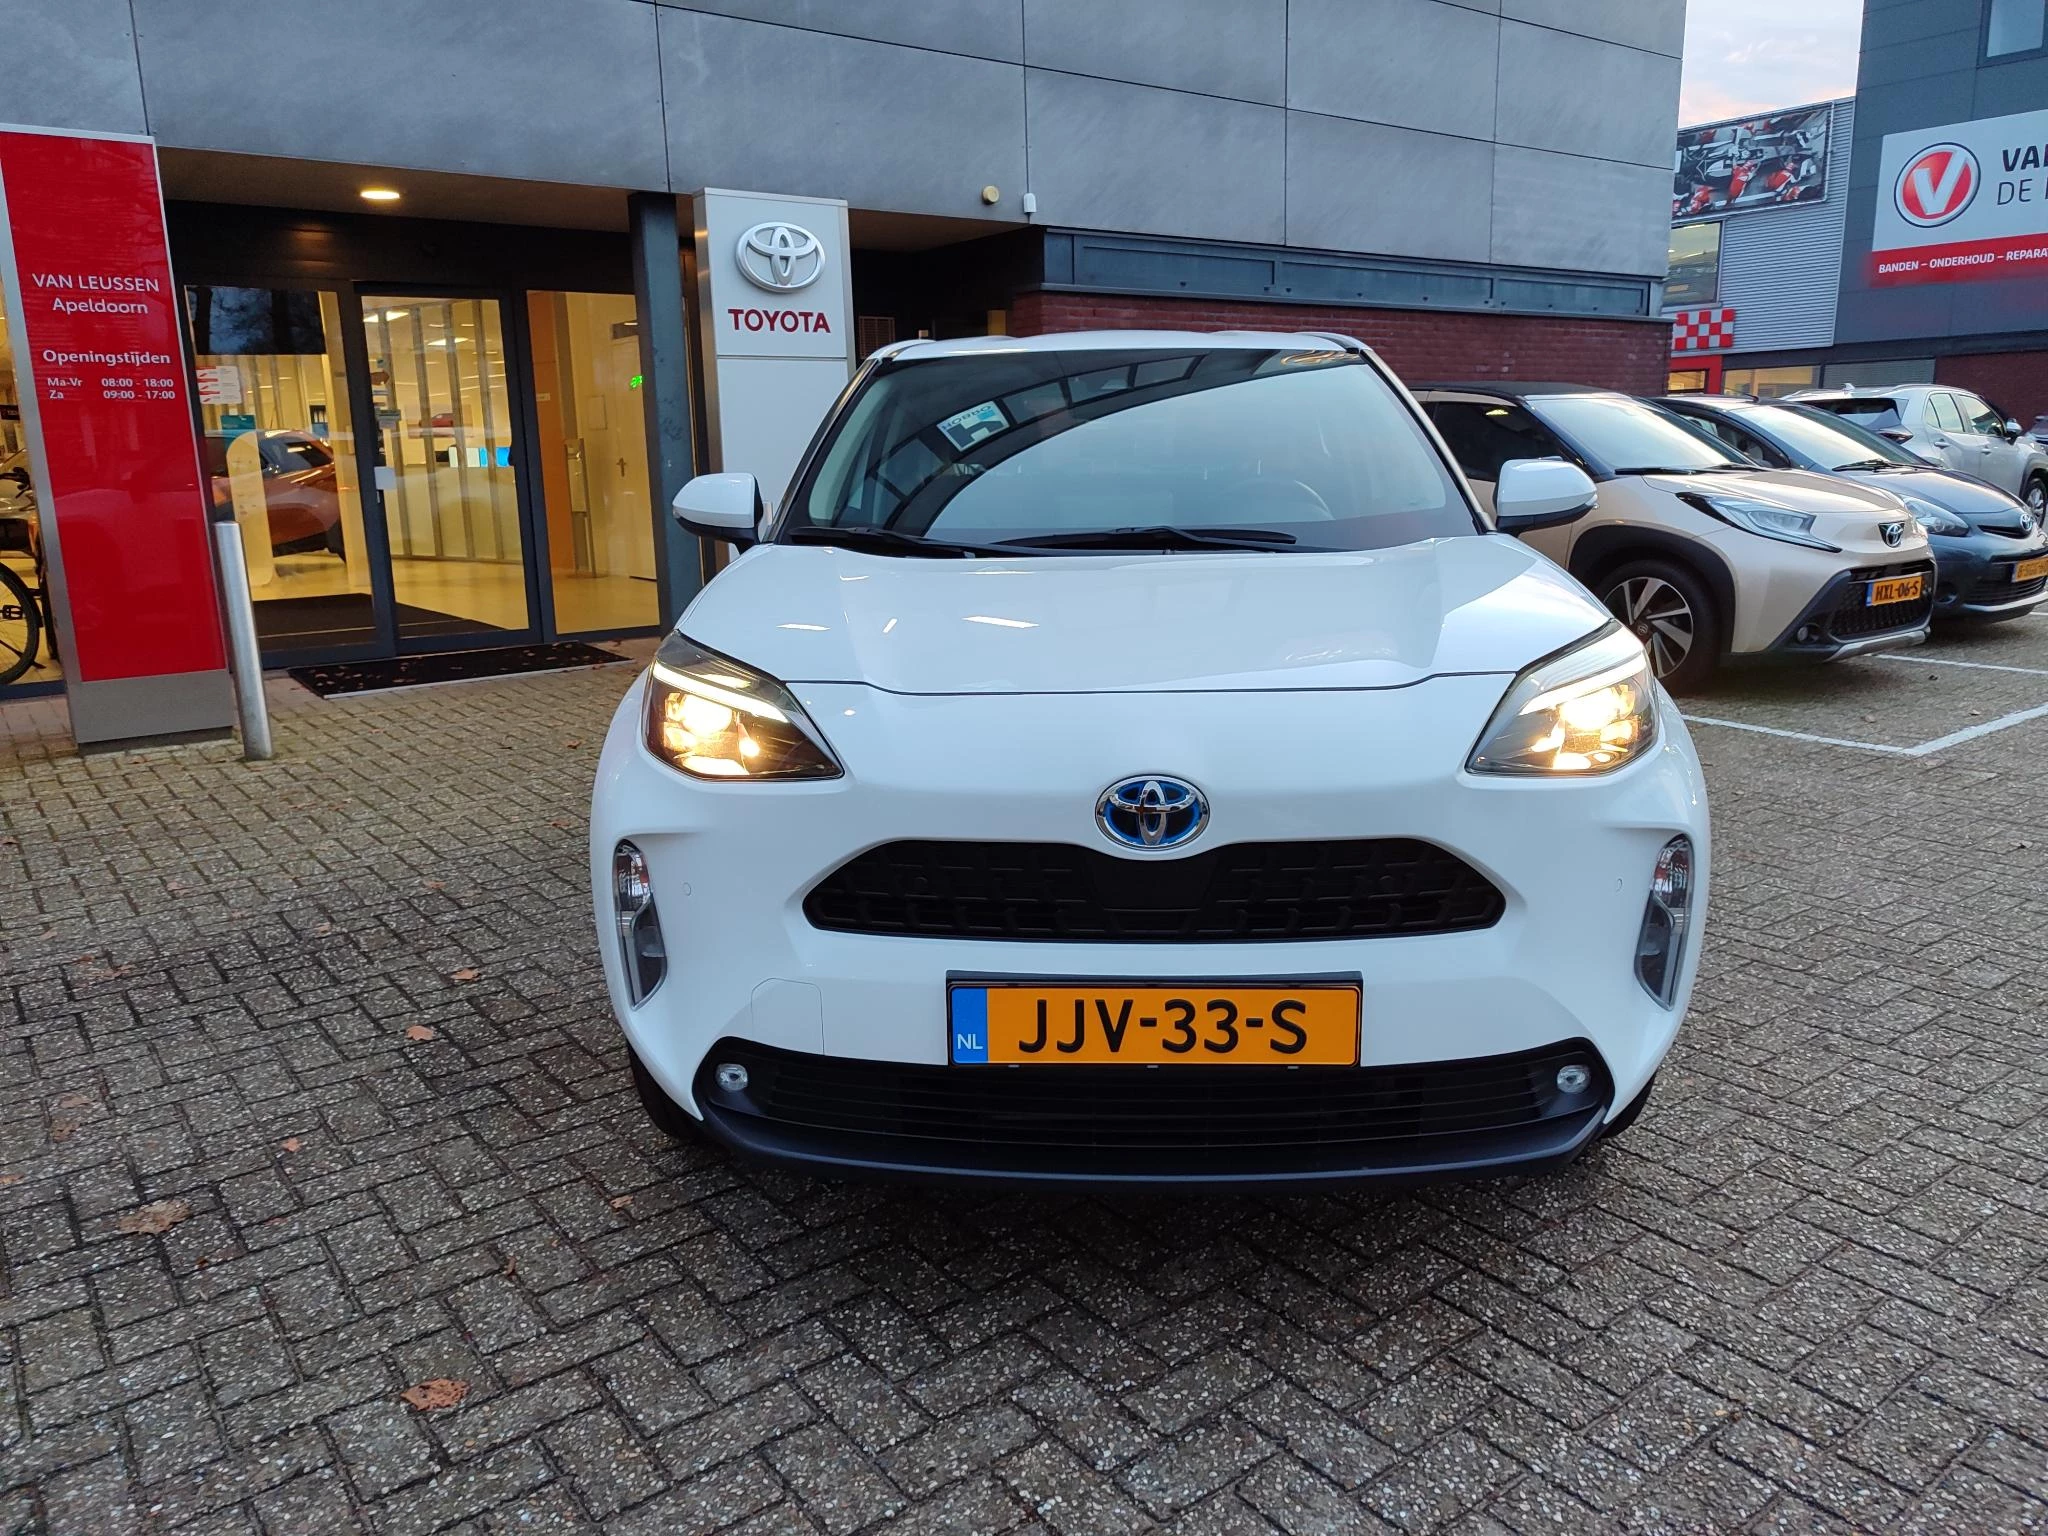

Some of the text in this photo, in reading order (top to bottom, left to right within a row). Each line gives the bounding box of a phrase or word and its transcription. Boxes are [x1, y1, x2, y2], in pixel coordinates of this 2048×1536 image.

[2002, 143, 2048, 172] VA
[1997, 178, 2033, 206] DE
[1878, 260, 1919, 274] BANDEN
[1929, 252, 1995, 269] ONDERHOUD
[2006, 247, 2048, 261] REPARA
[32, 273, 160, 292] VAN LEUSSEN
[52, 297, 148, 315] Apeldoorn
[727, 308, 831, 333] TOYOTA
[42, 349, 171, 367] Openingstijden
[47, 377, 83, 387] Ma-Vr
[101, 377, 133, 387] 08:00
[144, 378, 174, 387] 18:00
[49, 389, 64, 399] Za
[103, 390, 135, 399] 09:00
[145, 390, 176, 399] 17:00
[1018, 998, 1308, 1054] JJV-33-S
[957, 1033, 984, 1050] NL
